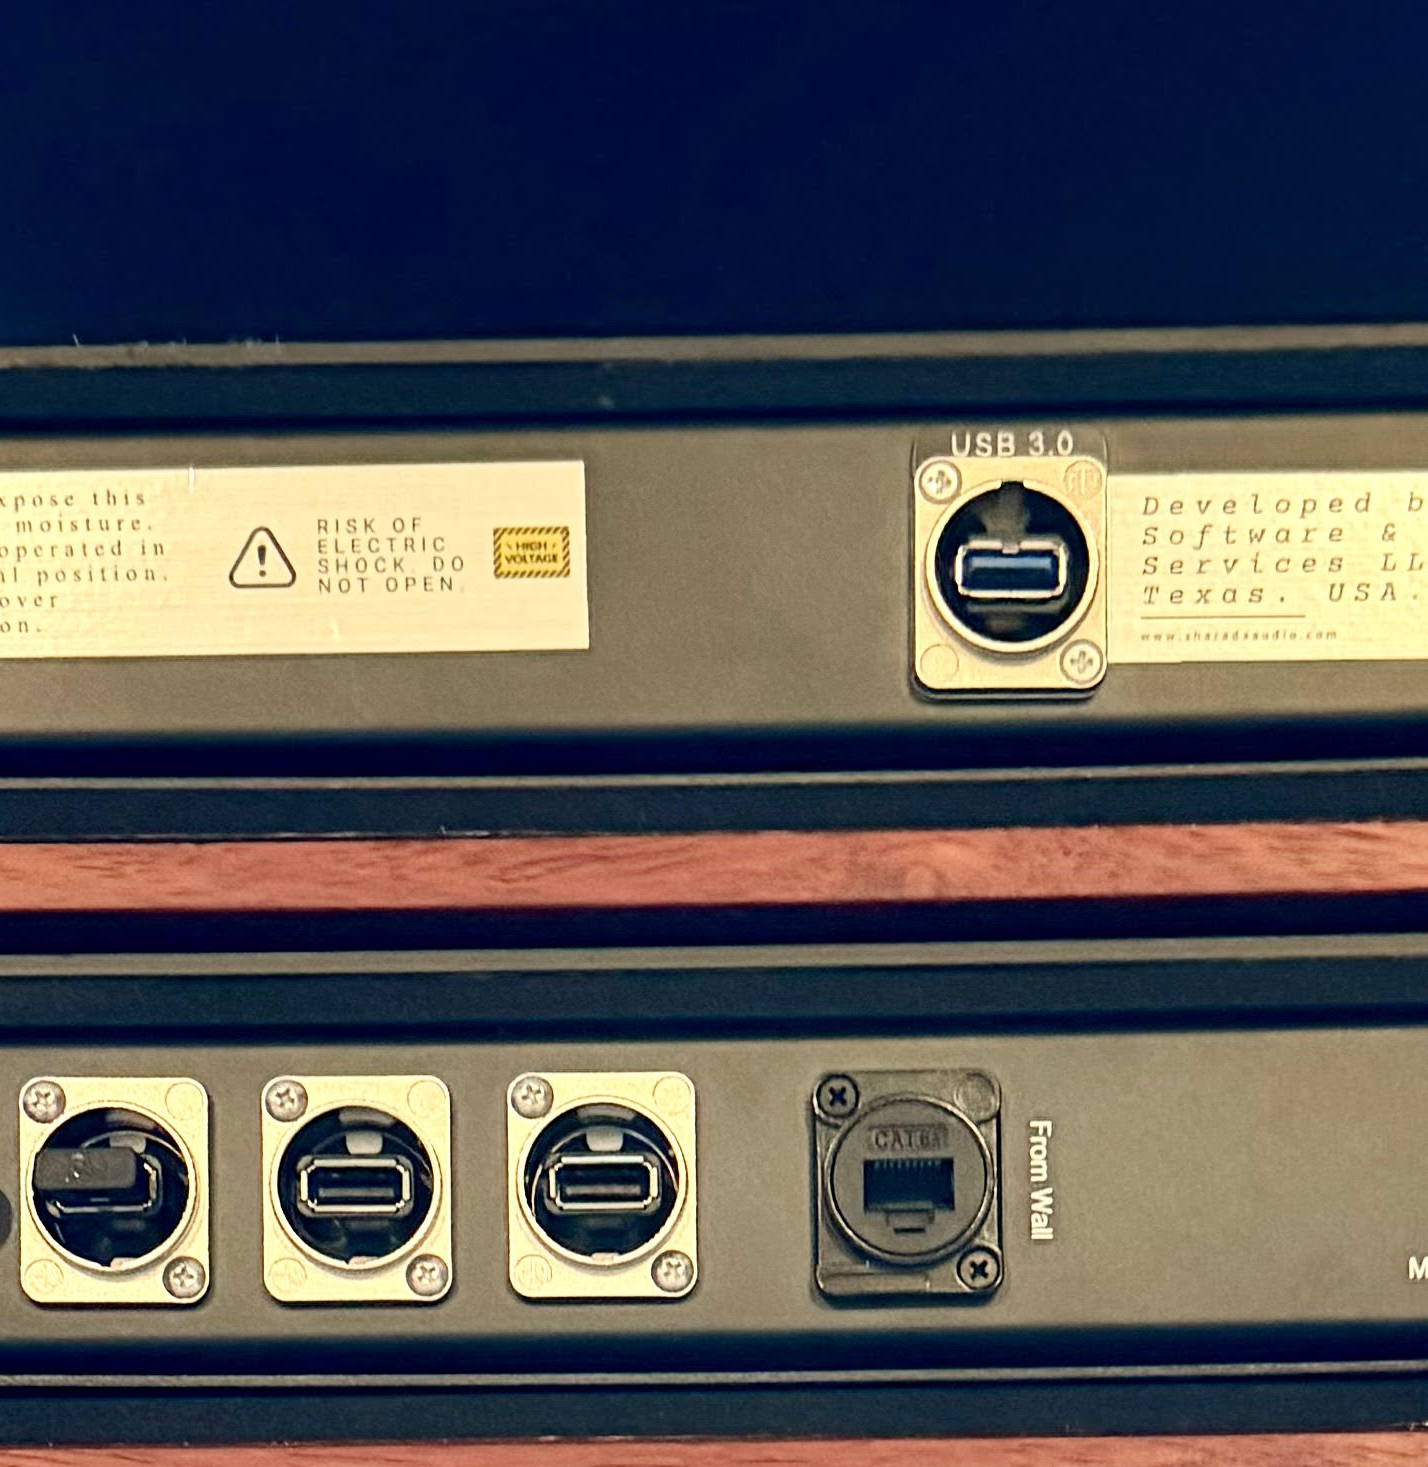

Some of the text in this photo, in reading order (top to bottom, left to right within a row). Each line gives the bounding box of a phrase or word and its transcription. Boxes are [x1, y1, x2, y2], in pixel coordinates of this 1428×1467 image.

[950, 430, 1074, 458] USB 3.0
[92, 489, 147, 507] this
[1142, 492, 1372, 519] Developed
[317, 517, 422, 534] RISK OF
[317, 536, 445, 554] ELECTRIC
[1142, 523, 1344, 550] Software
[1381, 523, 1396, 542] &
[142, 540, 166, 556] in
[516, 541, 547, 551] HIGH
[433, 556, 464, 572] DO
[505, 554, 558, 564] VOLTAGE
[1142, 552, 1344, 575] Services
[37, 566, 170, 586] position.
[318, 578, 368, 594] NOT
[1028, 1120, 1054, 1240] From Wall
